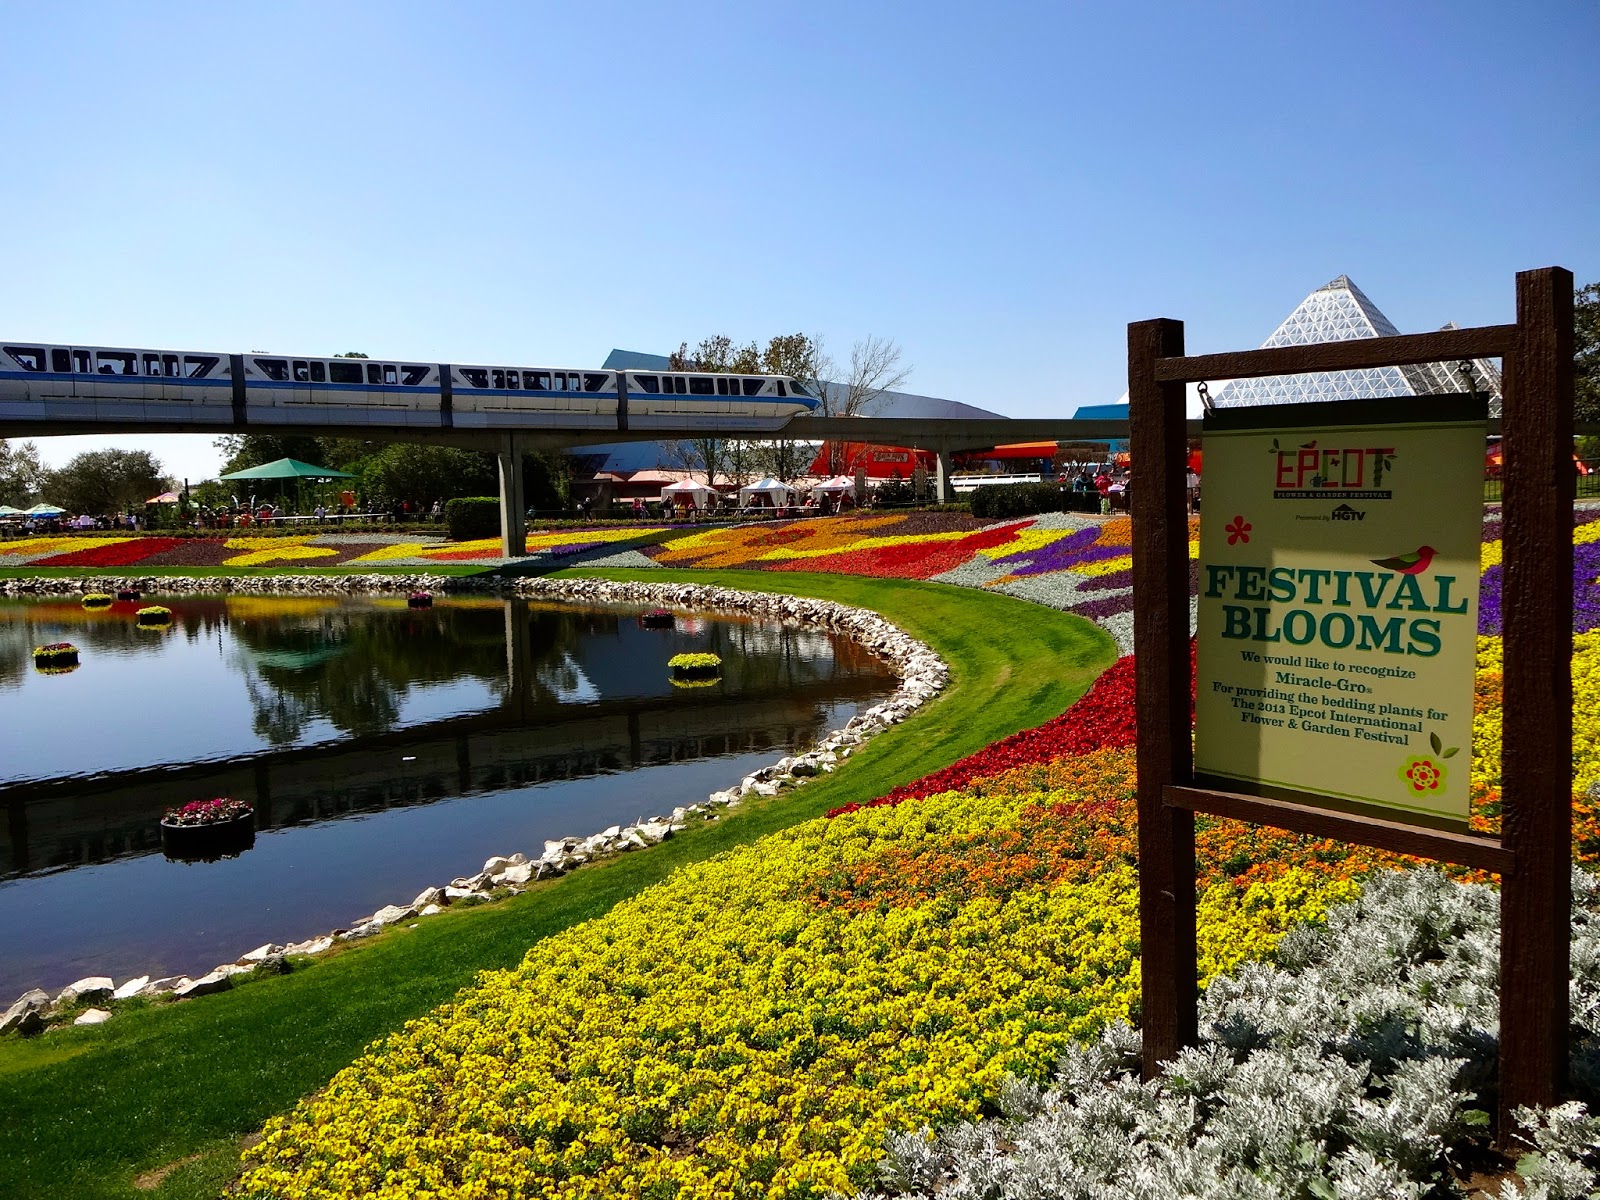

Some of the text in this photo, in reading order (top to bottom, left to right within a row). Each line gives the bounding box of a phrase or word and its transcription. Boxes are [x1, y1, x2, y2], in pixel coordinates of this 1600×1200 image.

[1276, 448, 1396, 488] EPCOT
[1331, 511, 1366, 521] HGTV
[1204, 564, 1469, 615] FESTIVAL
[1221, 604, 1442, 657] BLOOMS
[1241, 651, 1416, 679] We would like to recognize
[1213, 681, 1448, 721] For providing the bedding plants for
[1231, 697, 1423, 733] The 2013 Epcot International
[1241, 712, 1409, 745] Flower & Garden Festival
